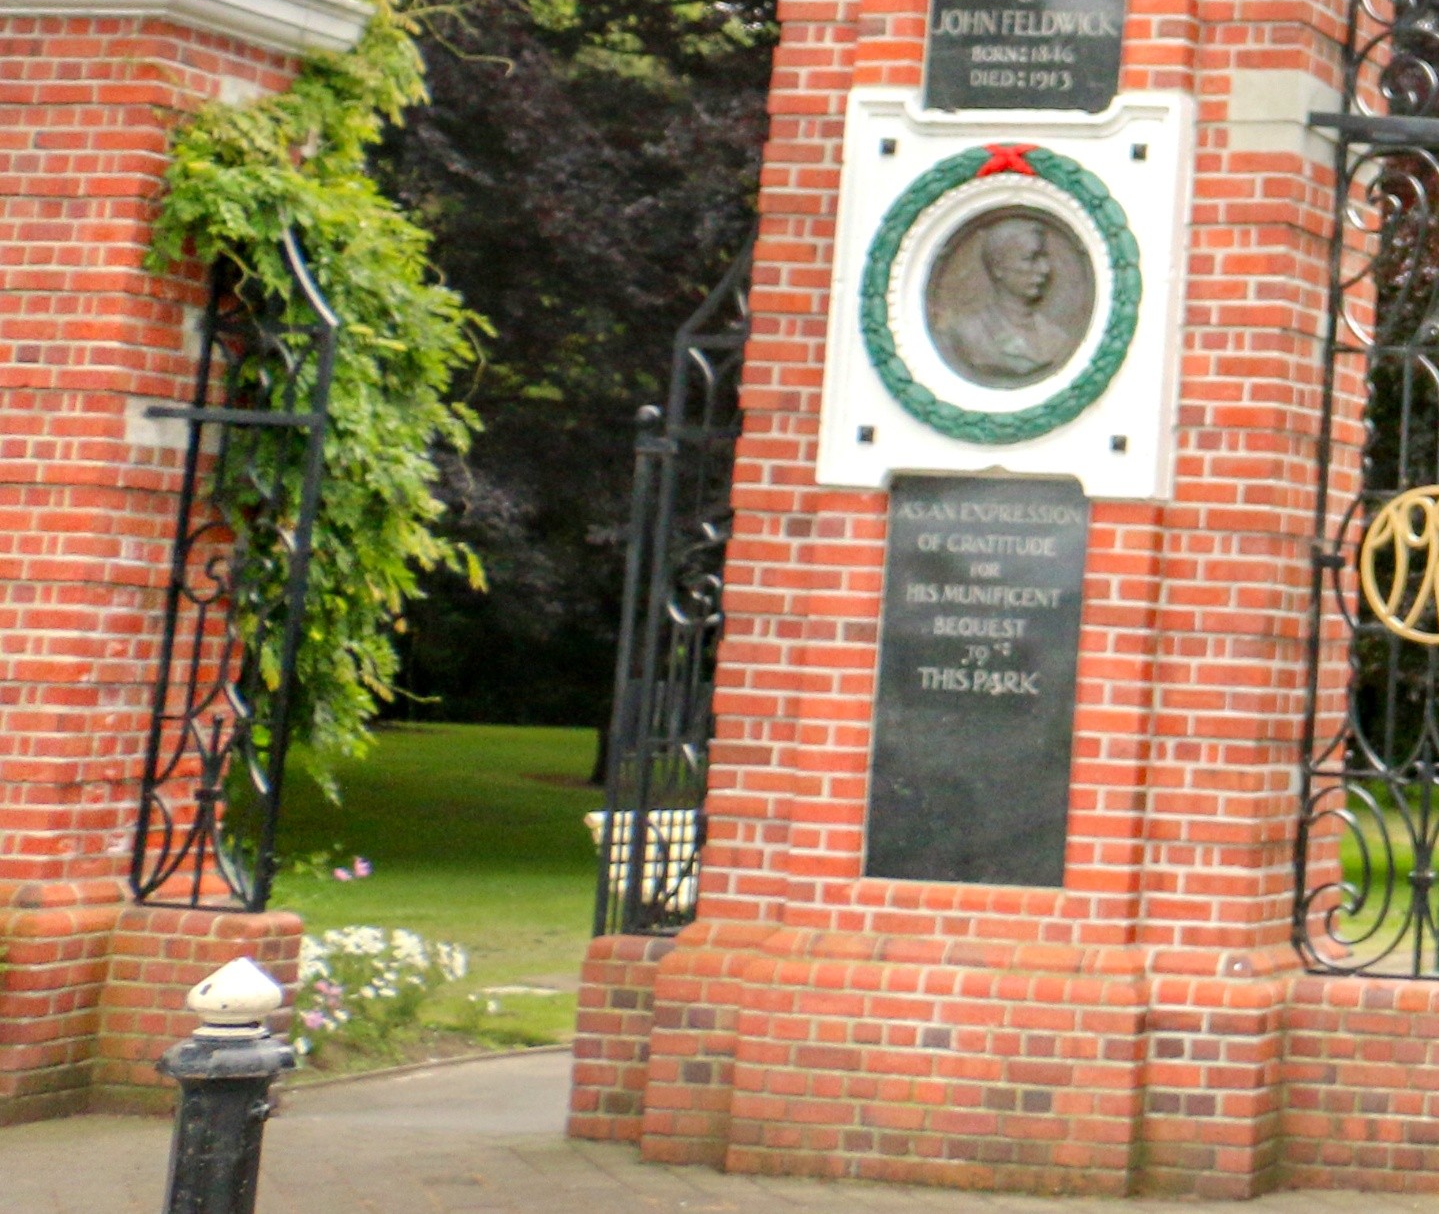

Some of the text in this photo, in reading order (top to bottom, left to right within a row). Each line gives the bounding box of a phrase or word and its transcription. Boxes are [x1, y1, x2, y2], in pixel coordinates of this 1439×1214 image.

[931, 9, 1119, 36] JOHN FELDWICK
[1030, 70, 1074, 91] 1913
[898, 501, 1083, 525] AS AN EXPRESSION
[917, 532, 1058, 557] OF GRATITUDE
[970, 561, 1002, 578] FOR
[905, 584, 1061, 609] HIS MUNIFICENT
[932, 617, 1027, 638] BEQUEST
[917, 666, 1041, 695] THIS PARK
